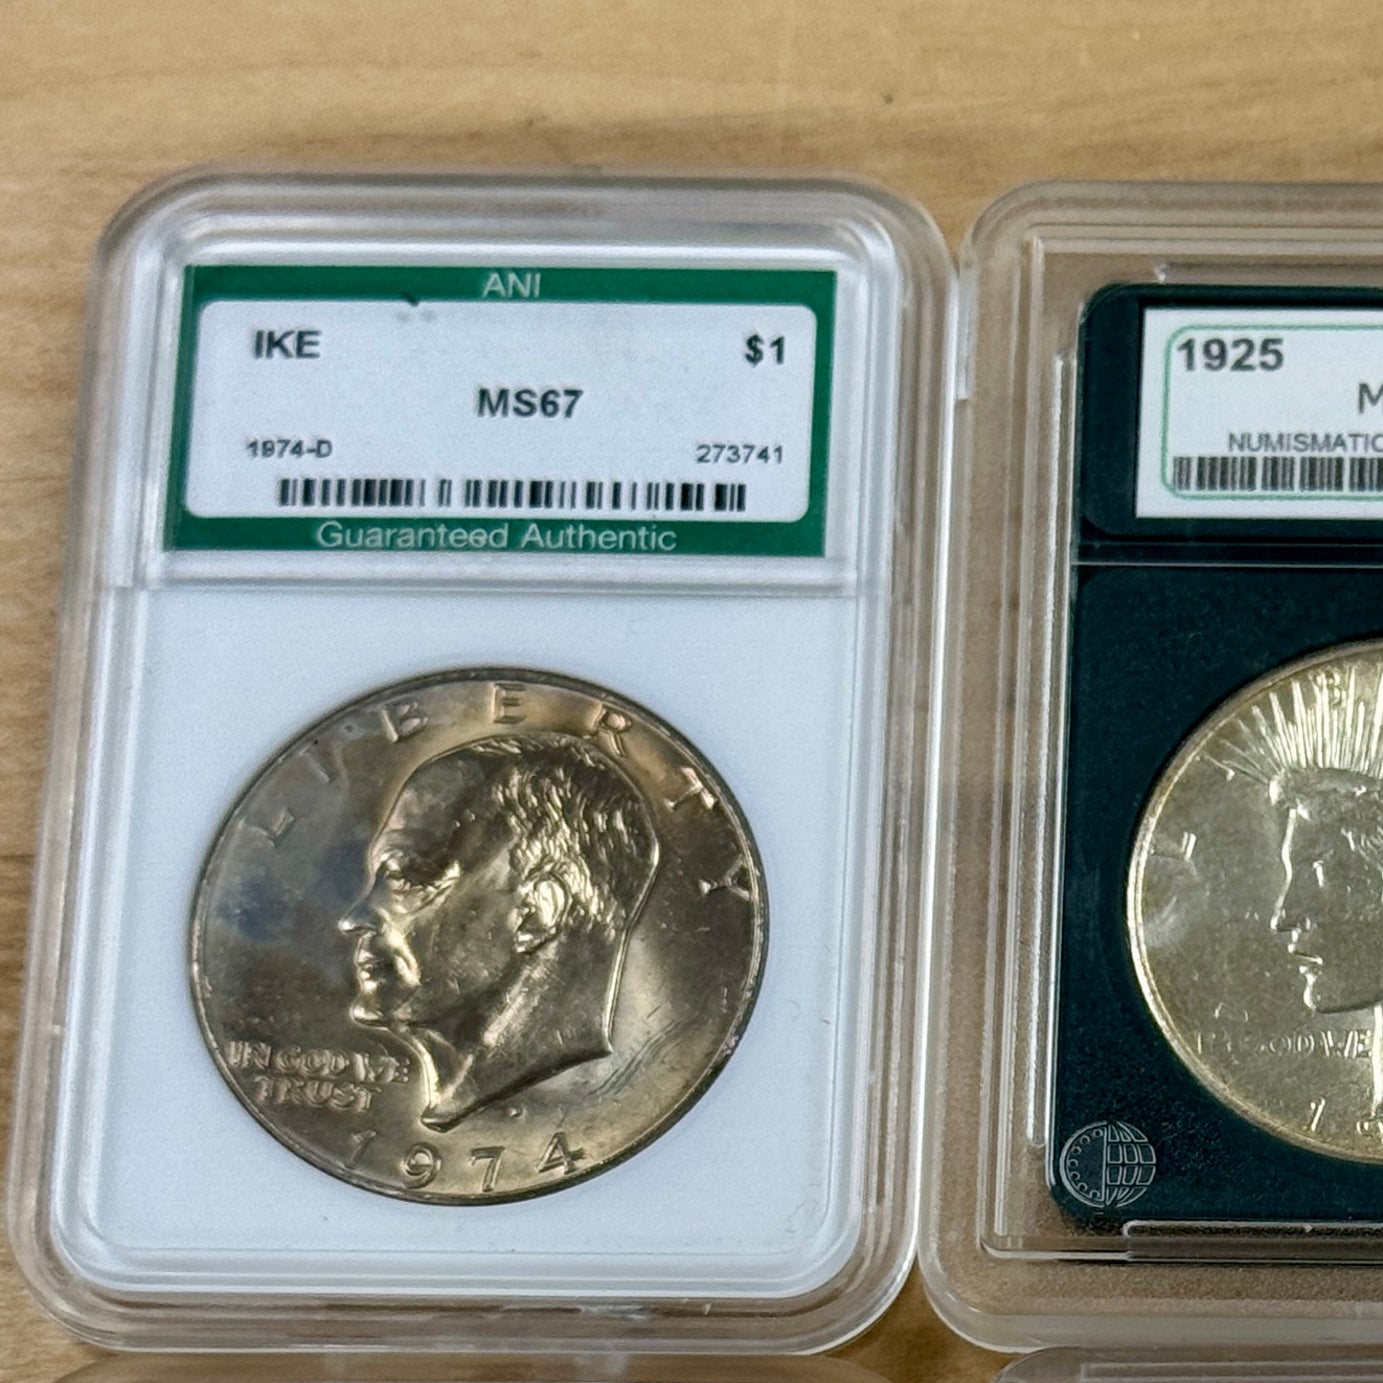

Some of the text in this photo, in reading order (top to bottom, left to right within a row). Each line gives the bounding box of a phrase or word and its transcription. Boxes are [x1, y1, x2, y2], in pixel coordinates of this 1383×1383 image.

[482, 273, 541, 298] ANI
[253, 329, 787, 366] IKE $1
[1176, 337, 1285, 373] 1925
[475, 387, 584, 419] MS67
[246, 438, 785, 464] 1974-D 273741
[316, 521, 677, 552] Guaranteed Authentic
[342, 1129, 587, 1194] 1974
